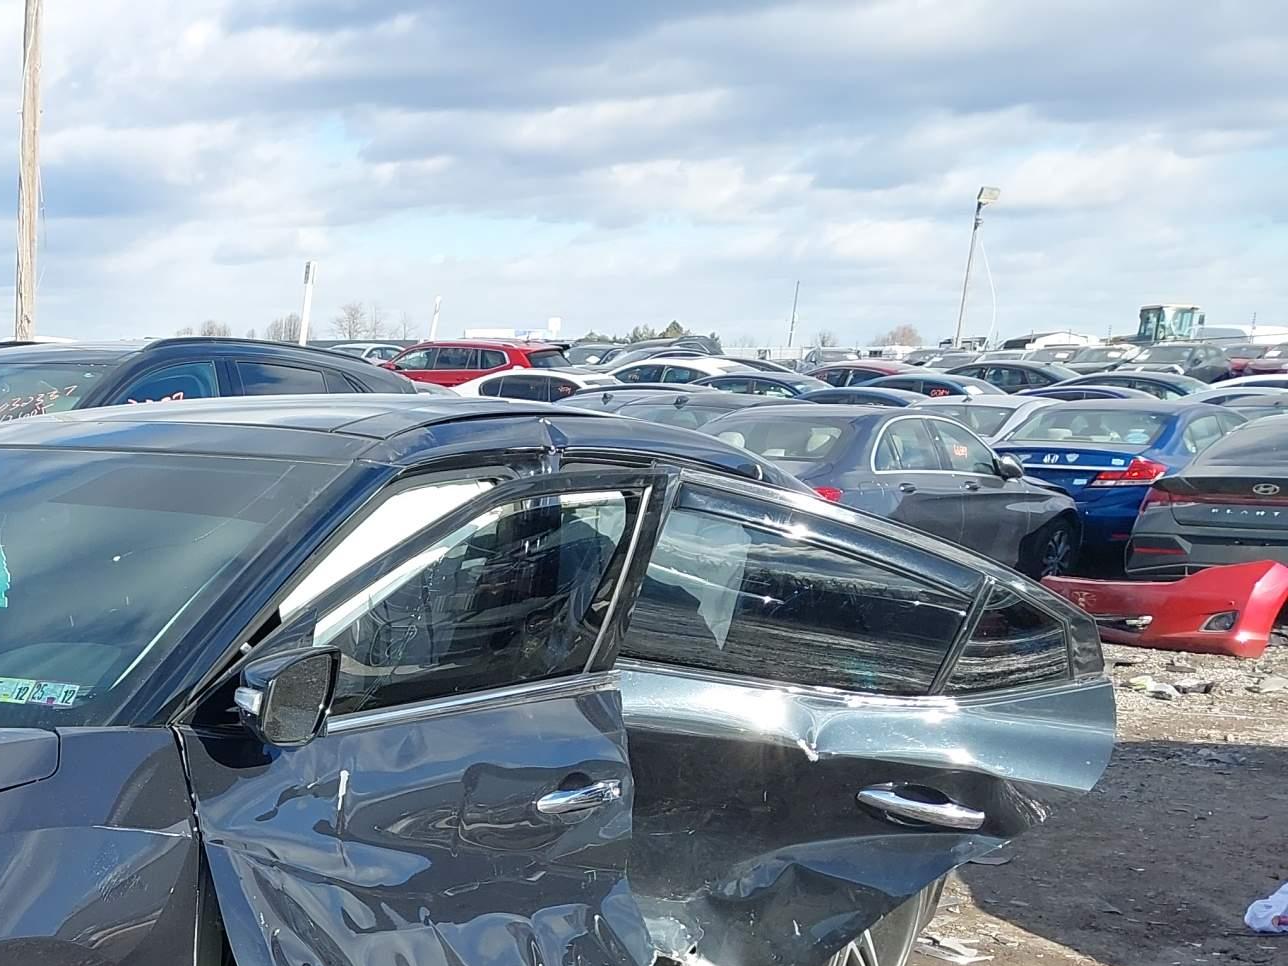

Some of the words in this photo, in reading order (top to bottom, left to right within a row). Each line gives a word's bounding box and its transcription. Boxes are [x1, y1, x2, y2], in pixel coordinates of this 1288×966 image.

[14, 686, 30, 701] 12
[32, 683, 48, 701] 25
[60, 689, 76, 704] 12
